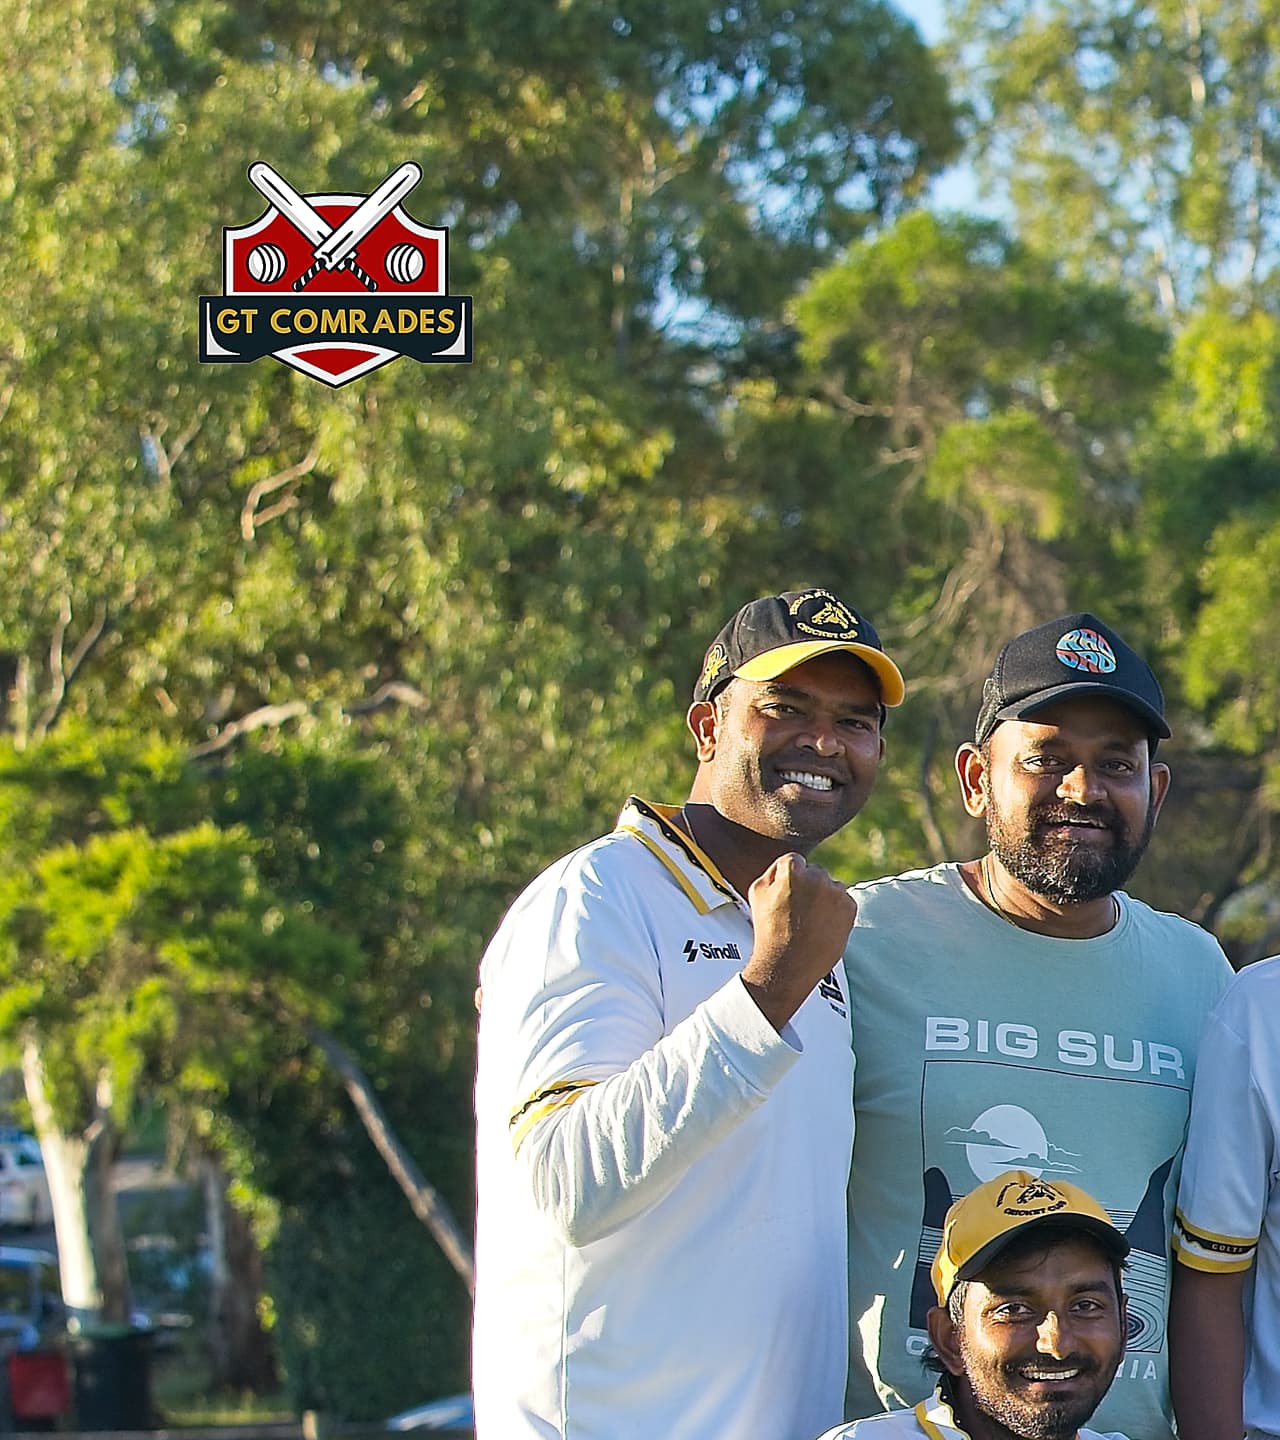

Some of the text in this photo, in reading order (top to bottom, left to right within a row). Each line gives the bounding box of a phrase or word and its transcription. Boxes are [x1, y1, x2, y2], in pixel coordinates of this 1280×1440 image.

[700, 942, 742, 961] Sinalli
[925, 1016, 1185, 1080] BIG SUR
